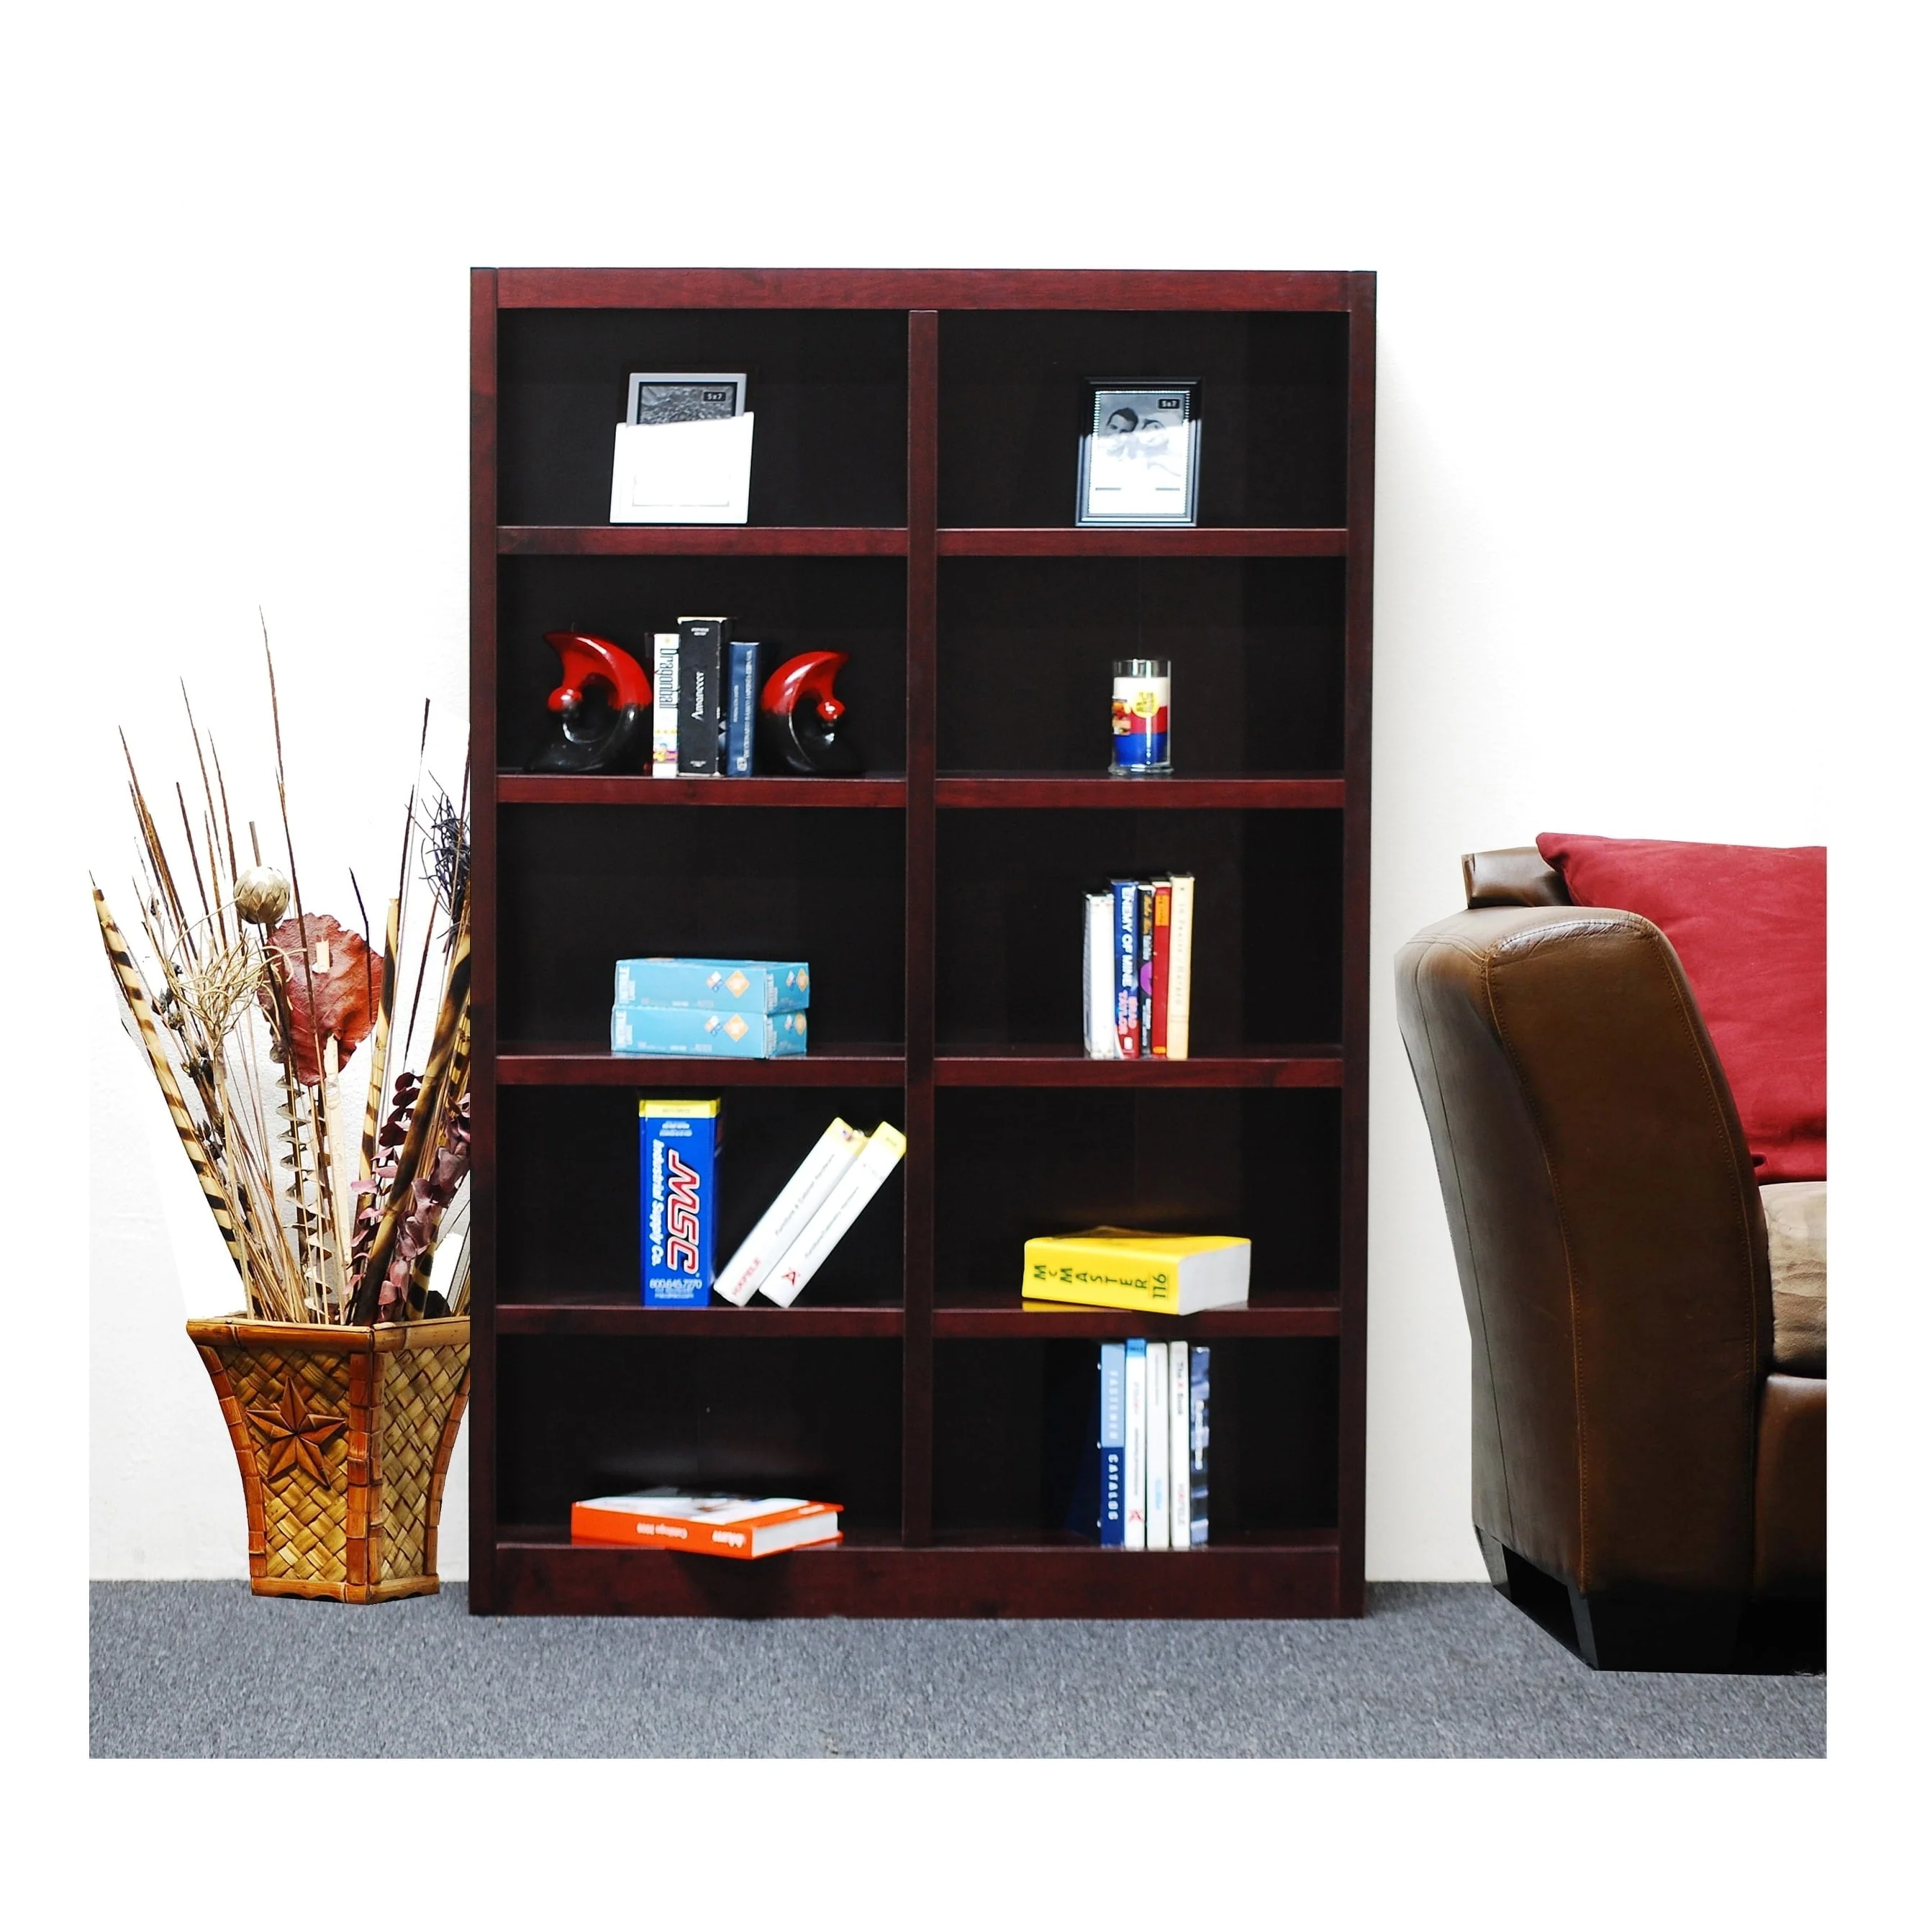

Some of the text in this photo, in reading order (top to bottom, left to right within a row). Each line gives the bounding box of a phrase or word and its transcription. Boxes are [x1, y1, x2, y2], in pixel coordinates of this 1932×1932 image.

[656, 648, 679, 709] Dragonball
[1122, 886, 1136, 987] ENEMY OF MINE
[1118, 990, 1128, 1035] TAYLOR
[649, 1139, 665, 1266] Industrial Supply Co.
[667, 1148, 700, 1274] MSC
[1152, 1273, 1167, 1298] 116
[1108, 1453, 1119, 1520] CATALOG
